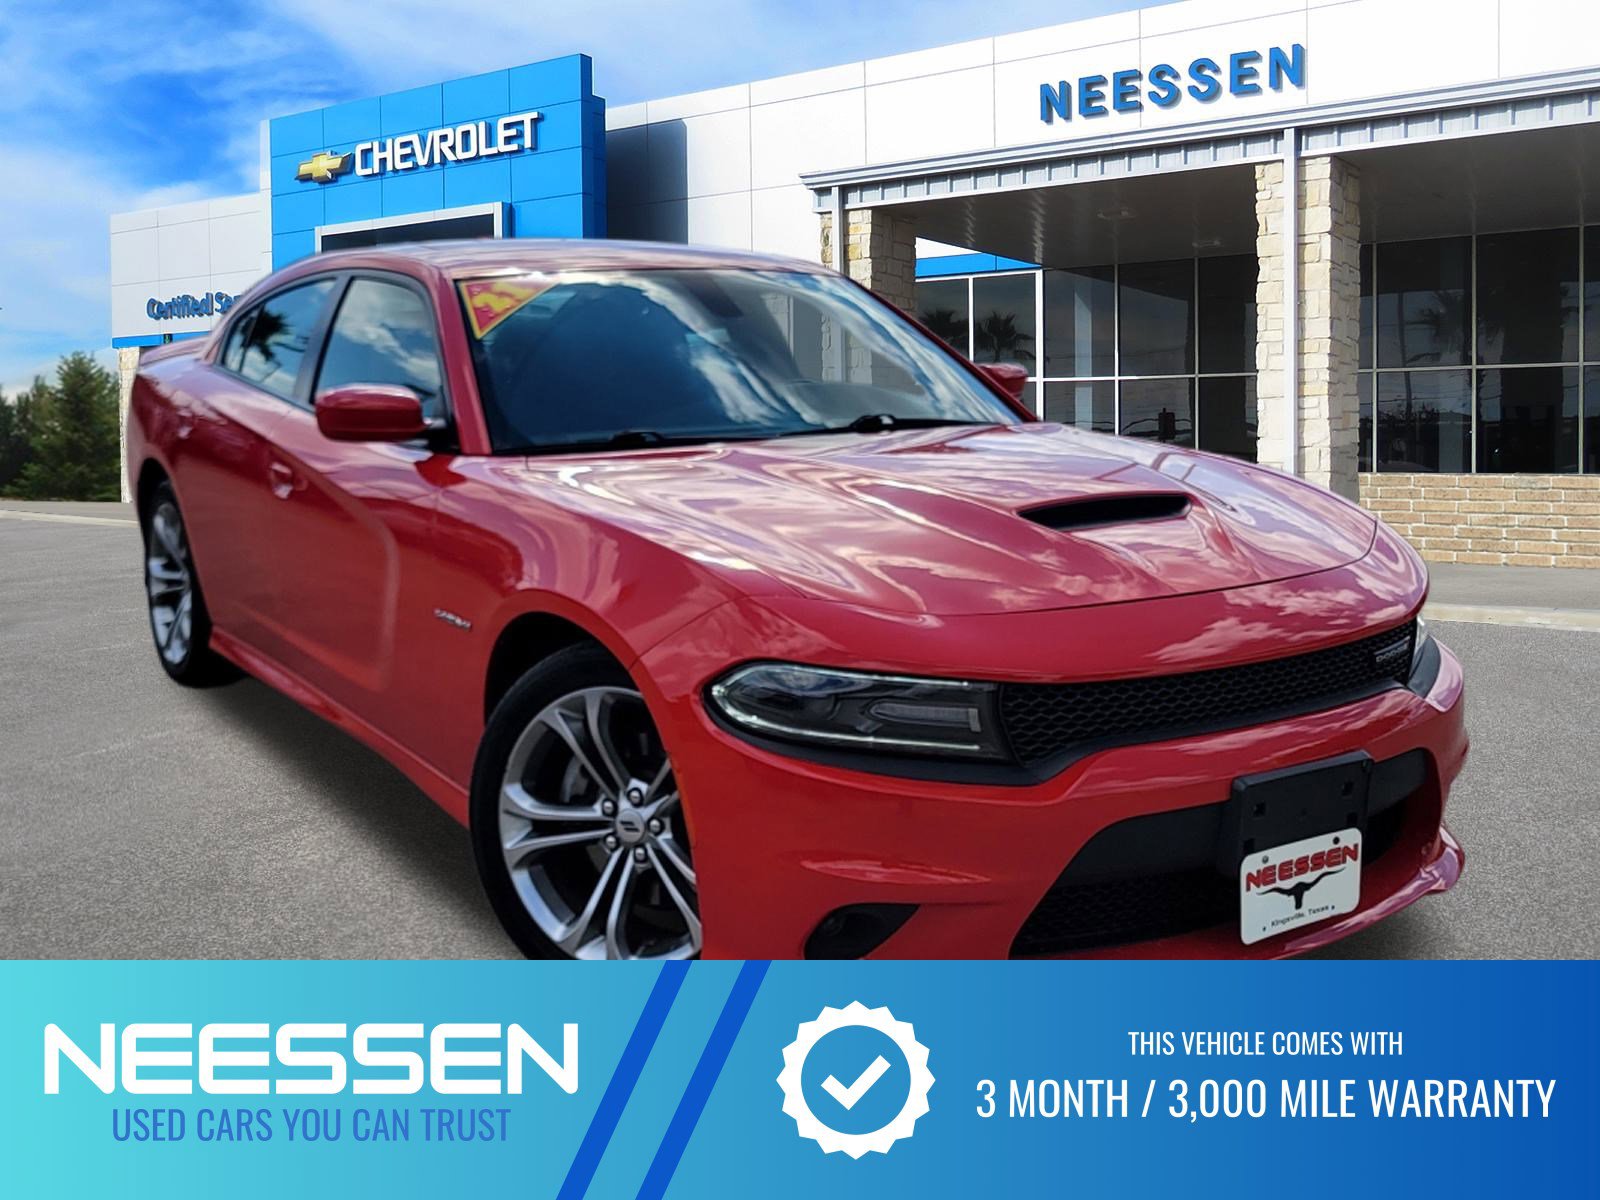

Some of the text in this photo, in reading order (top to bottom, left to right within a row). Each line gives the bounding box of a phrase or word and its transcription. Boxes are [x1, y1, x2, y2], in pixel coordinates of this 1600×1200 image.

[1039, 43, 1306, 124] NEESSEN
[354, 111, 544, 178] CHEVROLET
[146, 292, 214, 320] Certified
[1245, 843, 1359, 893] NEESSEN
